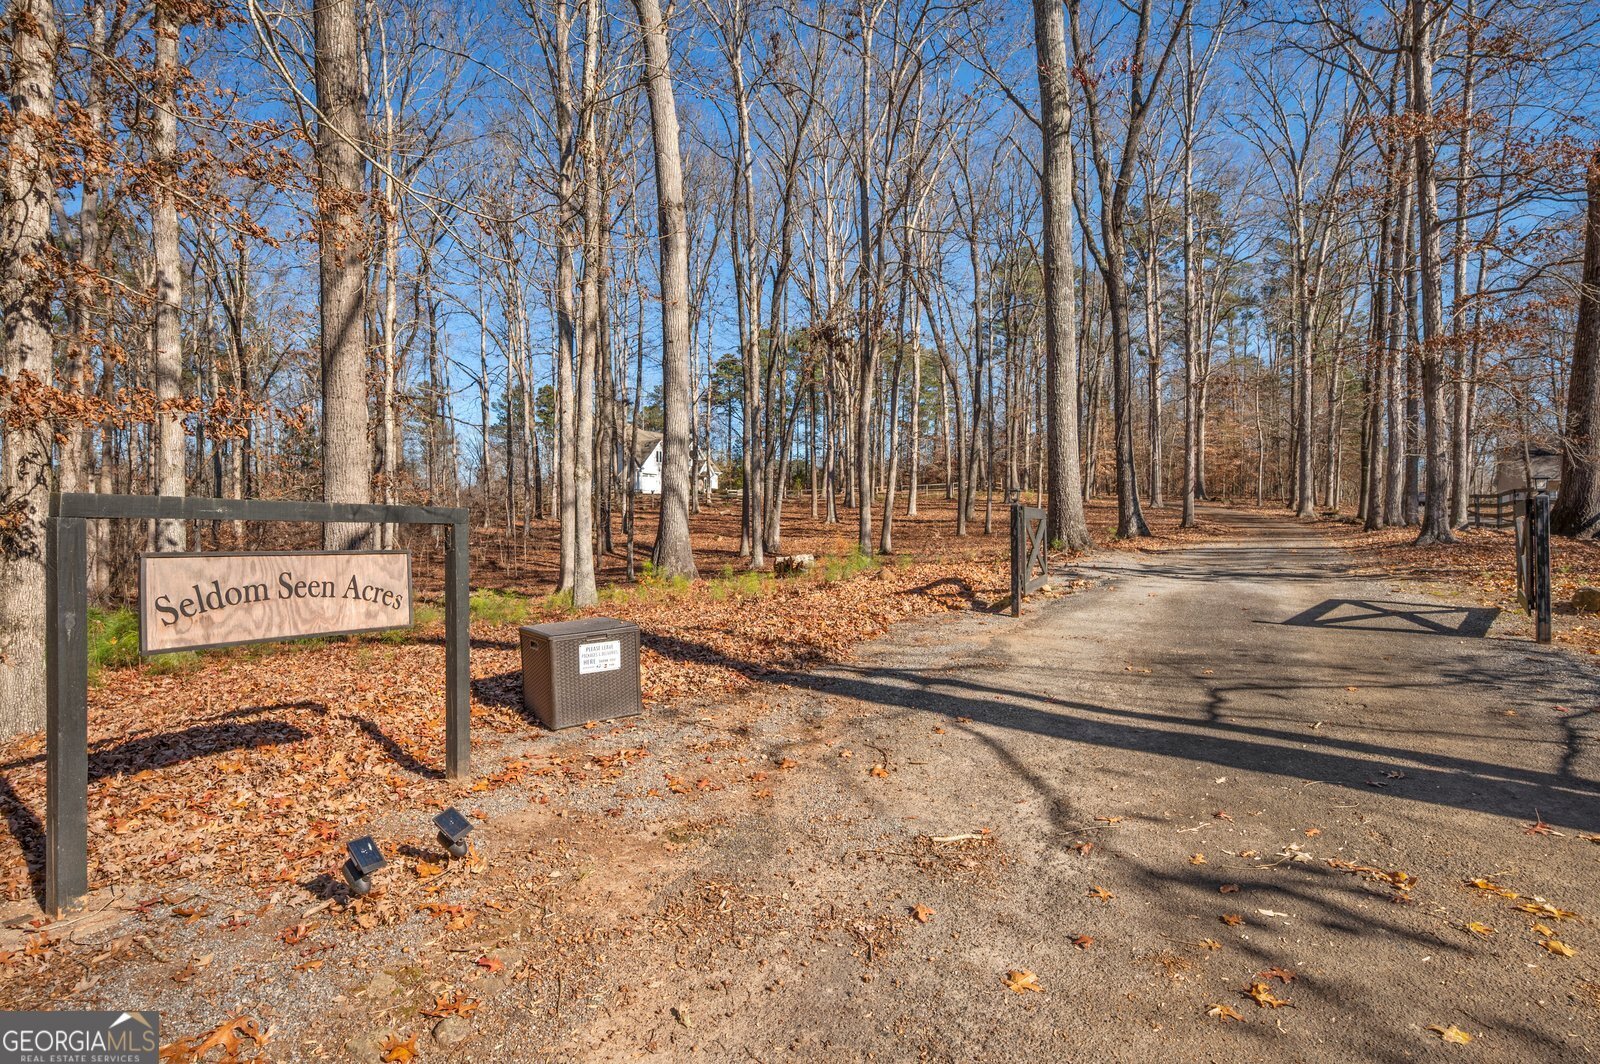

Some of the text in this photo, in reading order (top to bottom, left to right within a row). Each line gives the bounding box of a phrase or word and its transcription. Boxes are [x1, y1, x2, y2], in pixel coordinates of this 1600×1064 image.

[154, 571, 403, 627] Seldom Seen Acres
